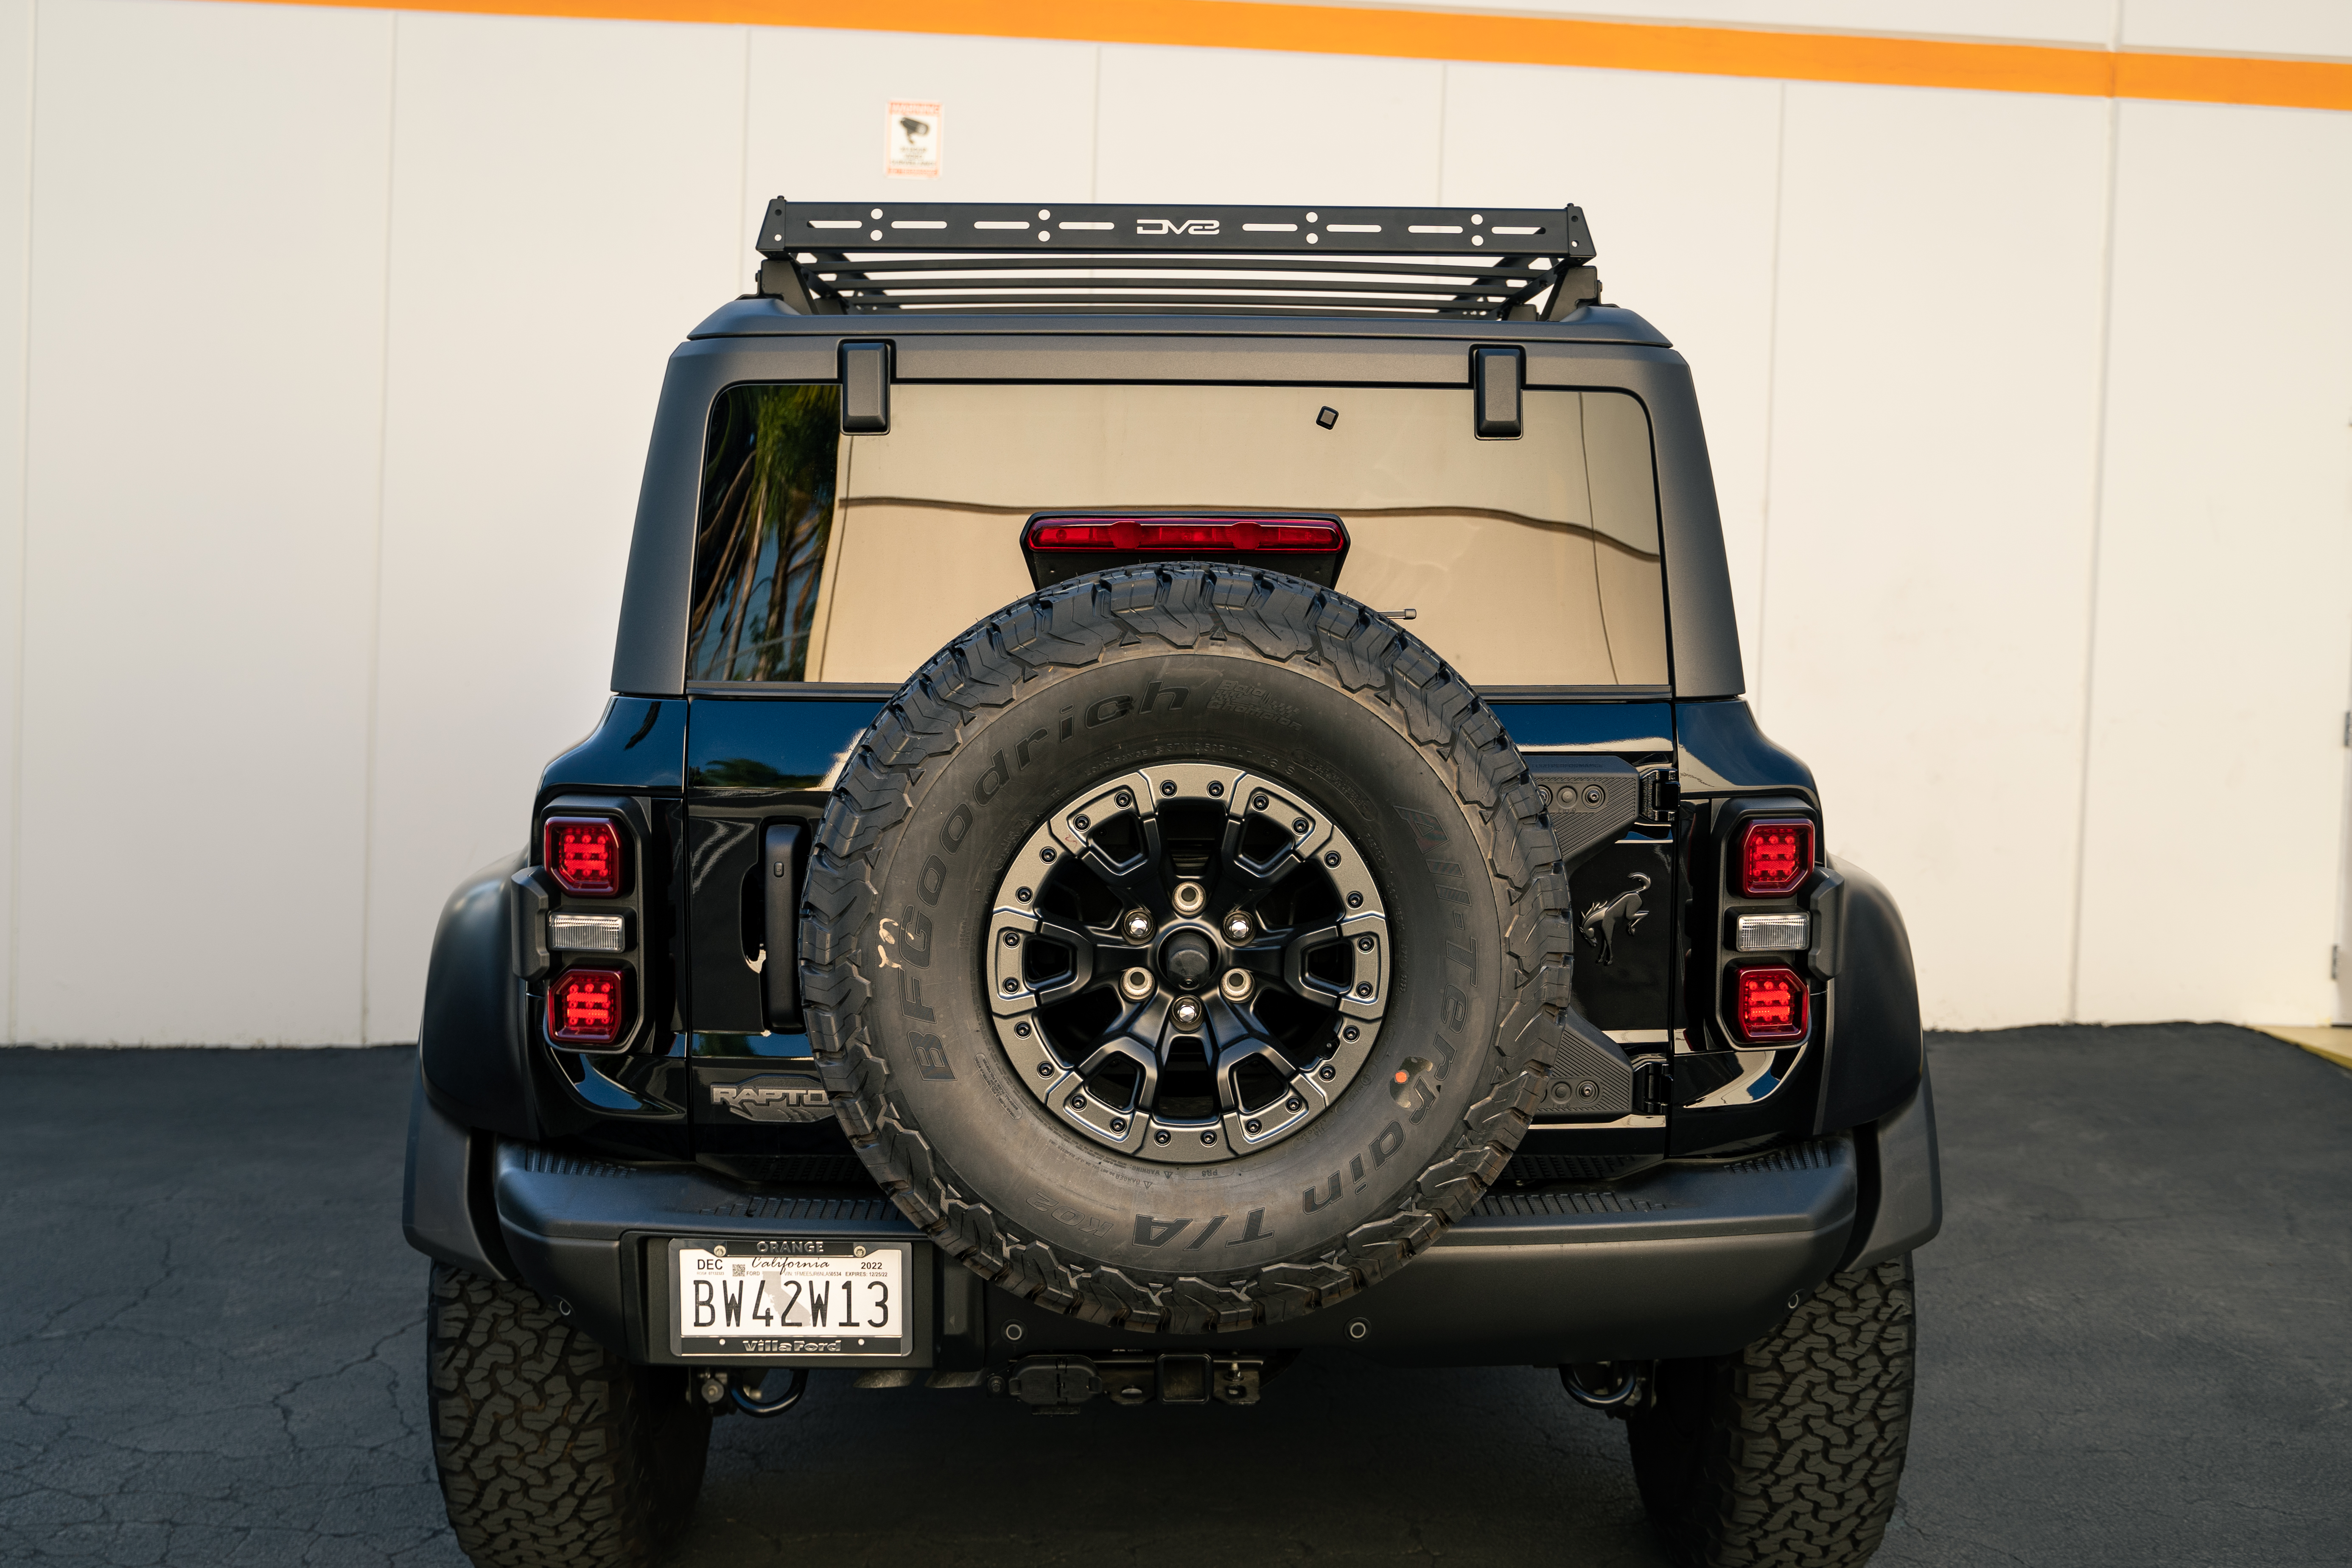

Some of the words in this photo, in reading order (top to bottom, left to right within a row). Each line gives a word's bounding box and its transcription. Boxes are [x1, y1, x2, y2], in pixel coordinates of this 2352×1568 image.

[1217, 680, 1267, 697] Baja
[1206, 699, 1303, 731] Champion
[1084, 760, 1111, 778] LOAD
[1113, 749, 1148, 765] RANGE
[1259, 753, 1279, 769] 116
[1283, 764, 1296, 777] S
[897, 681, 1191, 1082] BFGoodrich
[1303, 805, 1479, 1216] All-Terrain
[713, 1087, 830, 1108] RAPTO
[1114, 1173, 1140, 1185] DANGER
[1027, 1190, 1117, 1239] KO2
[1132, 1207, 1275, 1251] T/A
[757, 1241, 824, 1254] ORANGE
[697, 1259, 723, 1270] DEC
[752, 1257, 830, 1275] California
[693, 1280, 889, 1328] BW42W13
